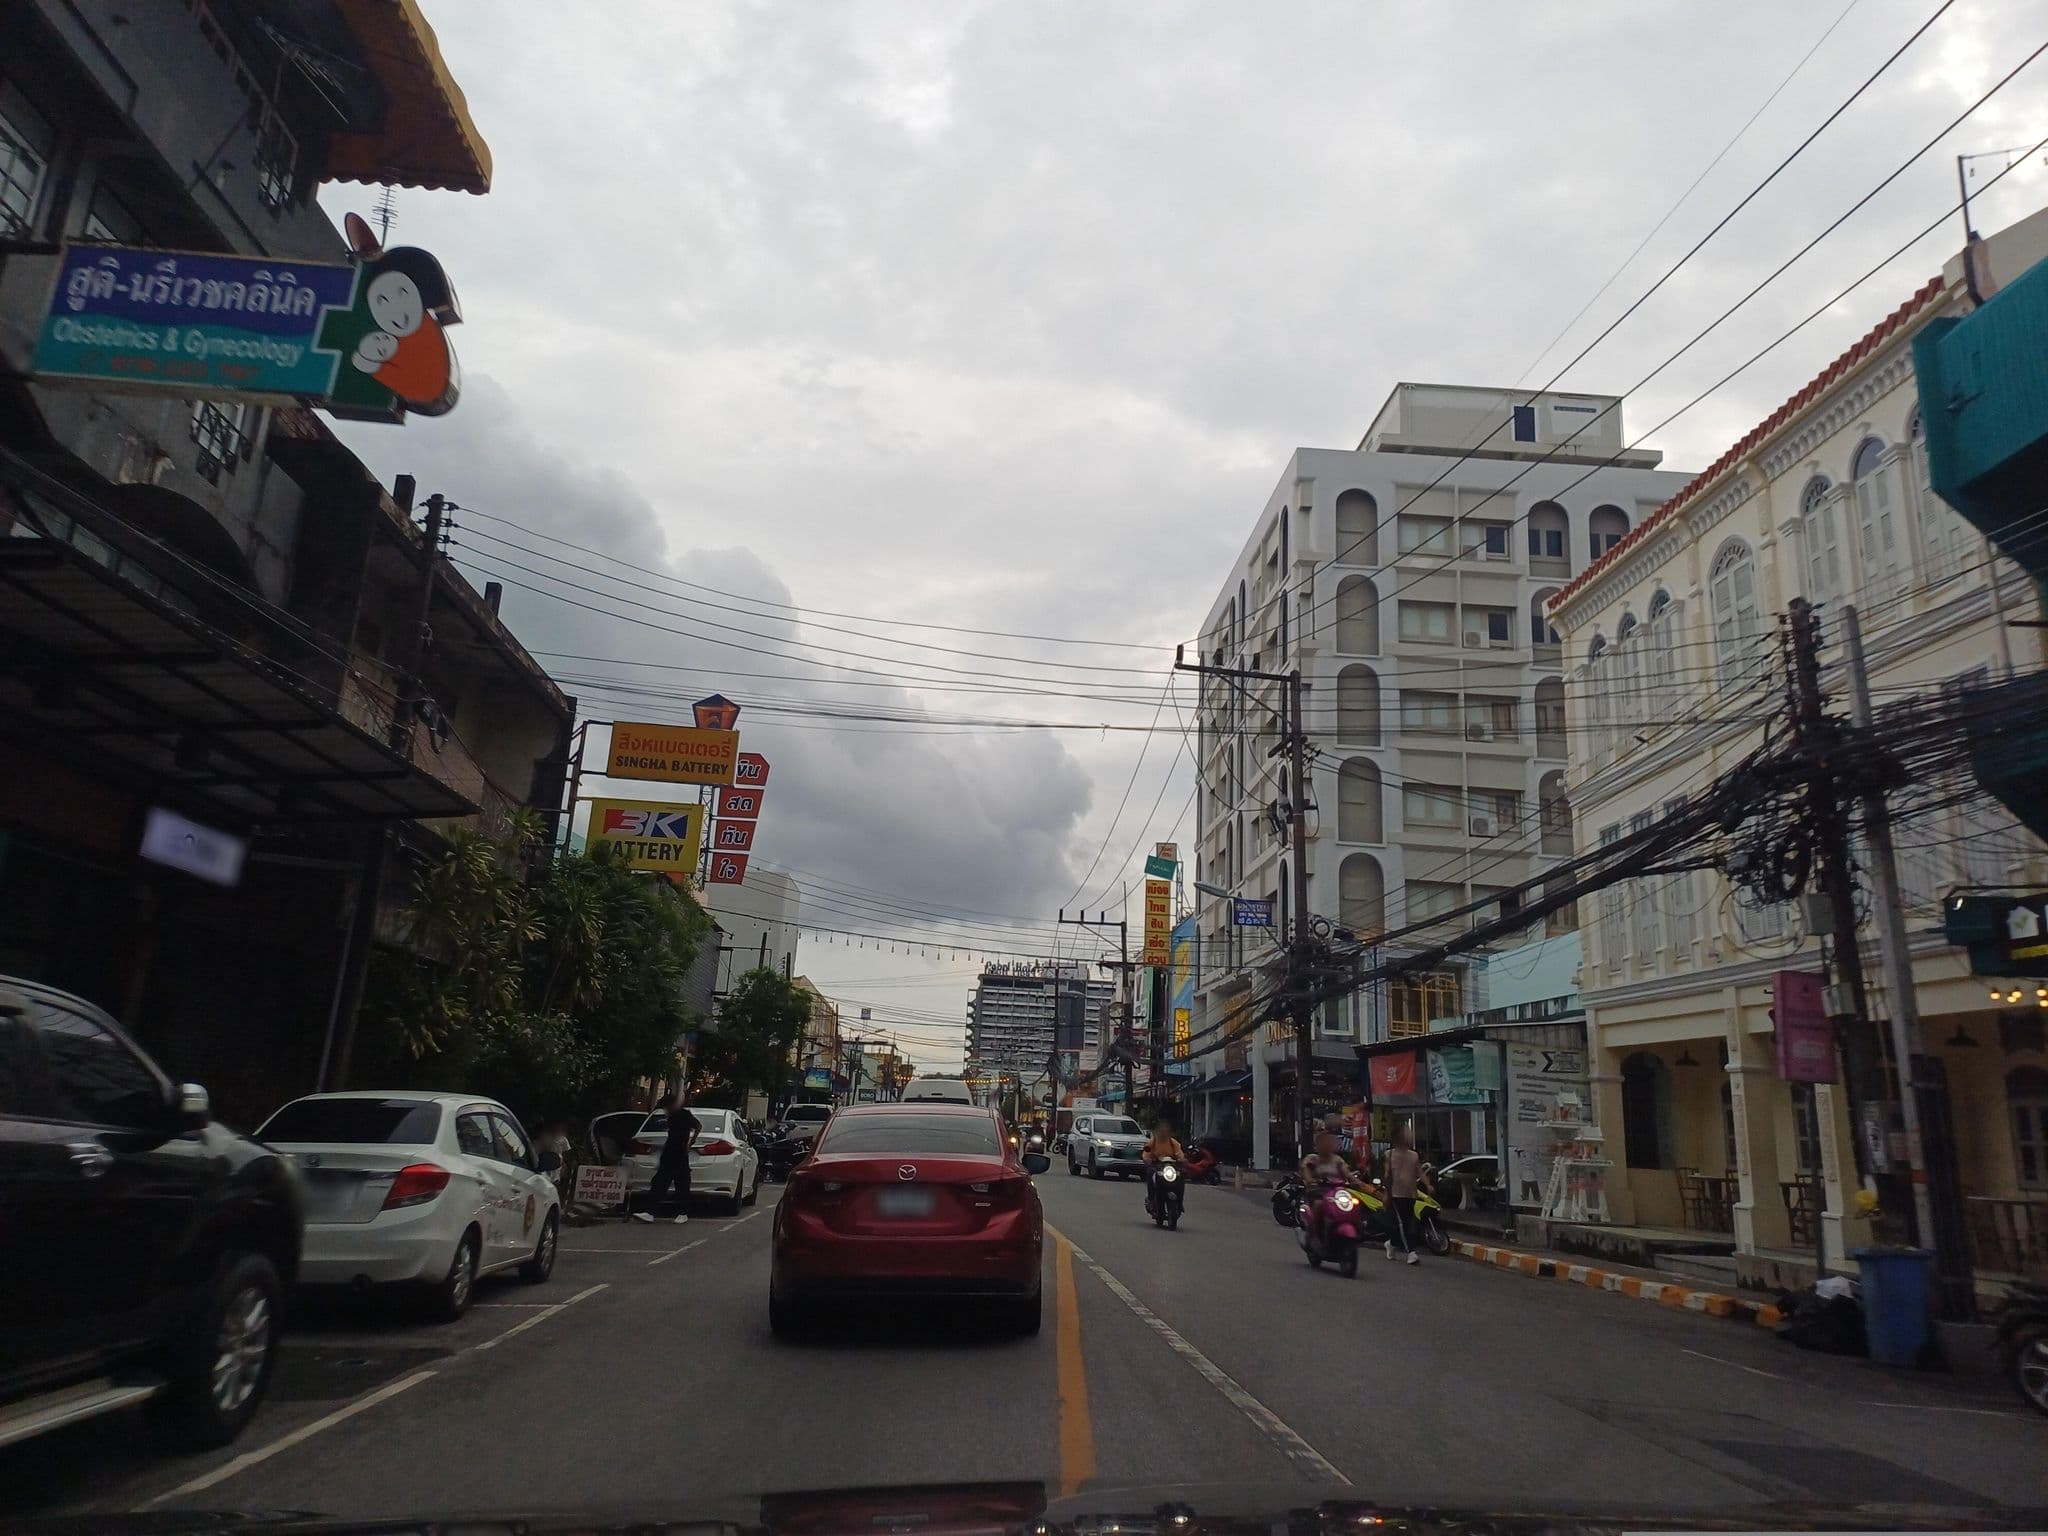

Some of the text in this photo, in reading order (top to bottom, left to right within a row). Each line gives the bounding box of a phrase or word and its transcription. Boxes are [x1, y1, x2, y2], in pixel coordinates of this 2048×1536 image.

[52, 317, 158, 350] Obstetrics
[161, 327, 180, 352] &
[183, 328, 305, 368] Gynecology
[615, 755, 729, 776] SINGHA BATTERY
[608, 840, 685, 862] ATTERY
